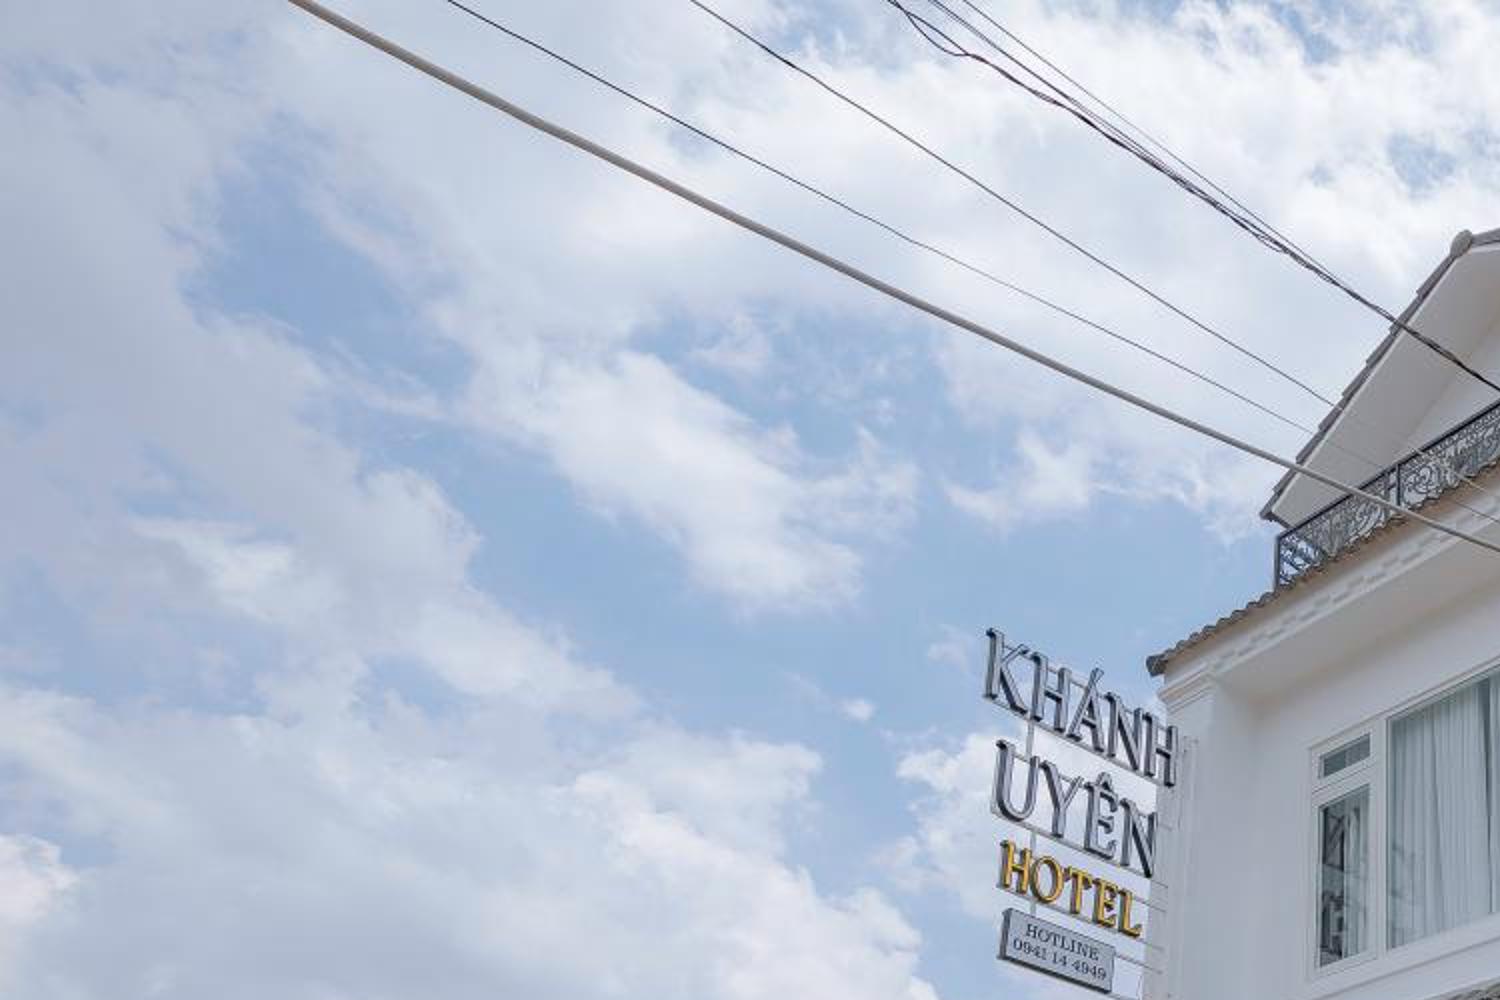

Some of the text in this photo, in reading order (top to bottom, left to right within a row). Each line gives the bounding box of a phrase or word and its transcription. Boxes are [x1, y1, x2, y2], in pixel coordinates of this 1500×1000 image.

[984, 627, 1179, 788] KHÁNH
[992, 739, 1158, 878] UYÊN
[999, 839, 1142, 938] HOTEL
[1026, 924, 1099, 961] HOTLINE
